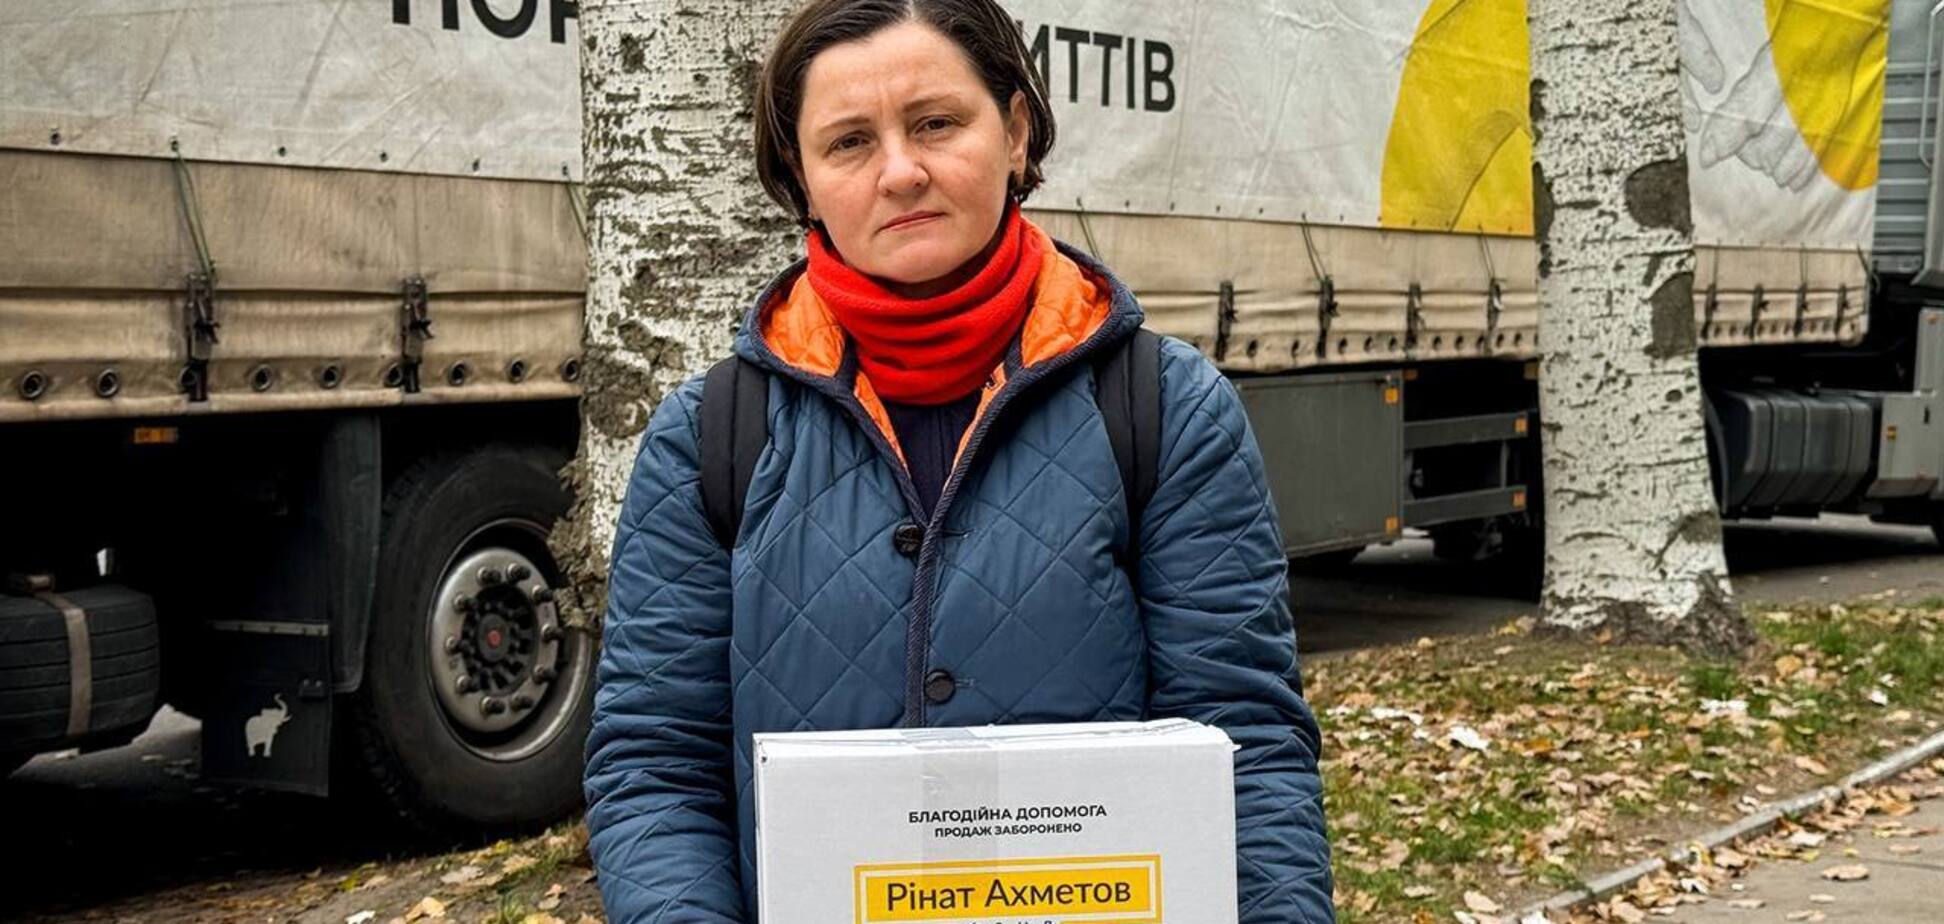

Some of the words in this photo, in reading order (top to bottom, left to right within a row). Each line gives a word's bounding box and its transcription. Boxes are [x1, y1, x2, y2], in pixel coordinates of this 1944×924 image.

[909, 806, 1012, 823] БЛАГОДІЙНА
[1016, 805, 1107, 821] ДОПОМОГА
[935, 826, 992, 838] ПРОДАЖ
[995, 823, 1083, 836] ЗАБОРОНЕНО
[887, 882, 975, 911] Рінат
[985, 879, 1131, 908] Ахметов
